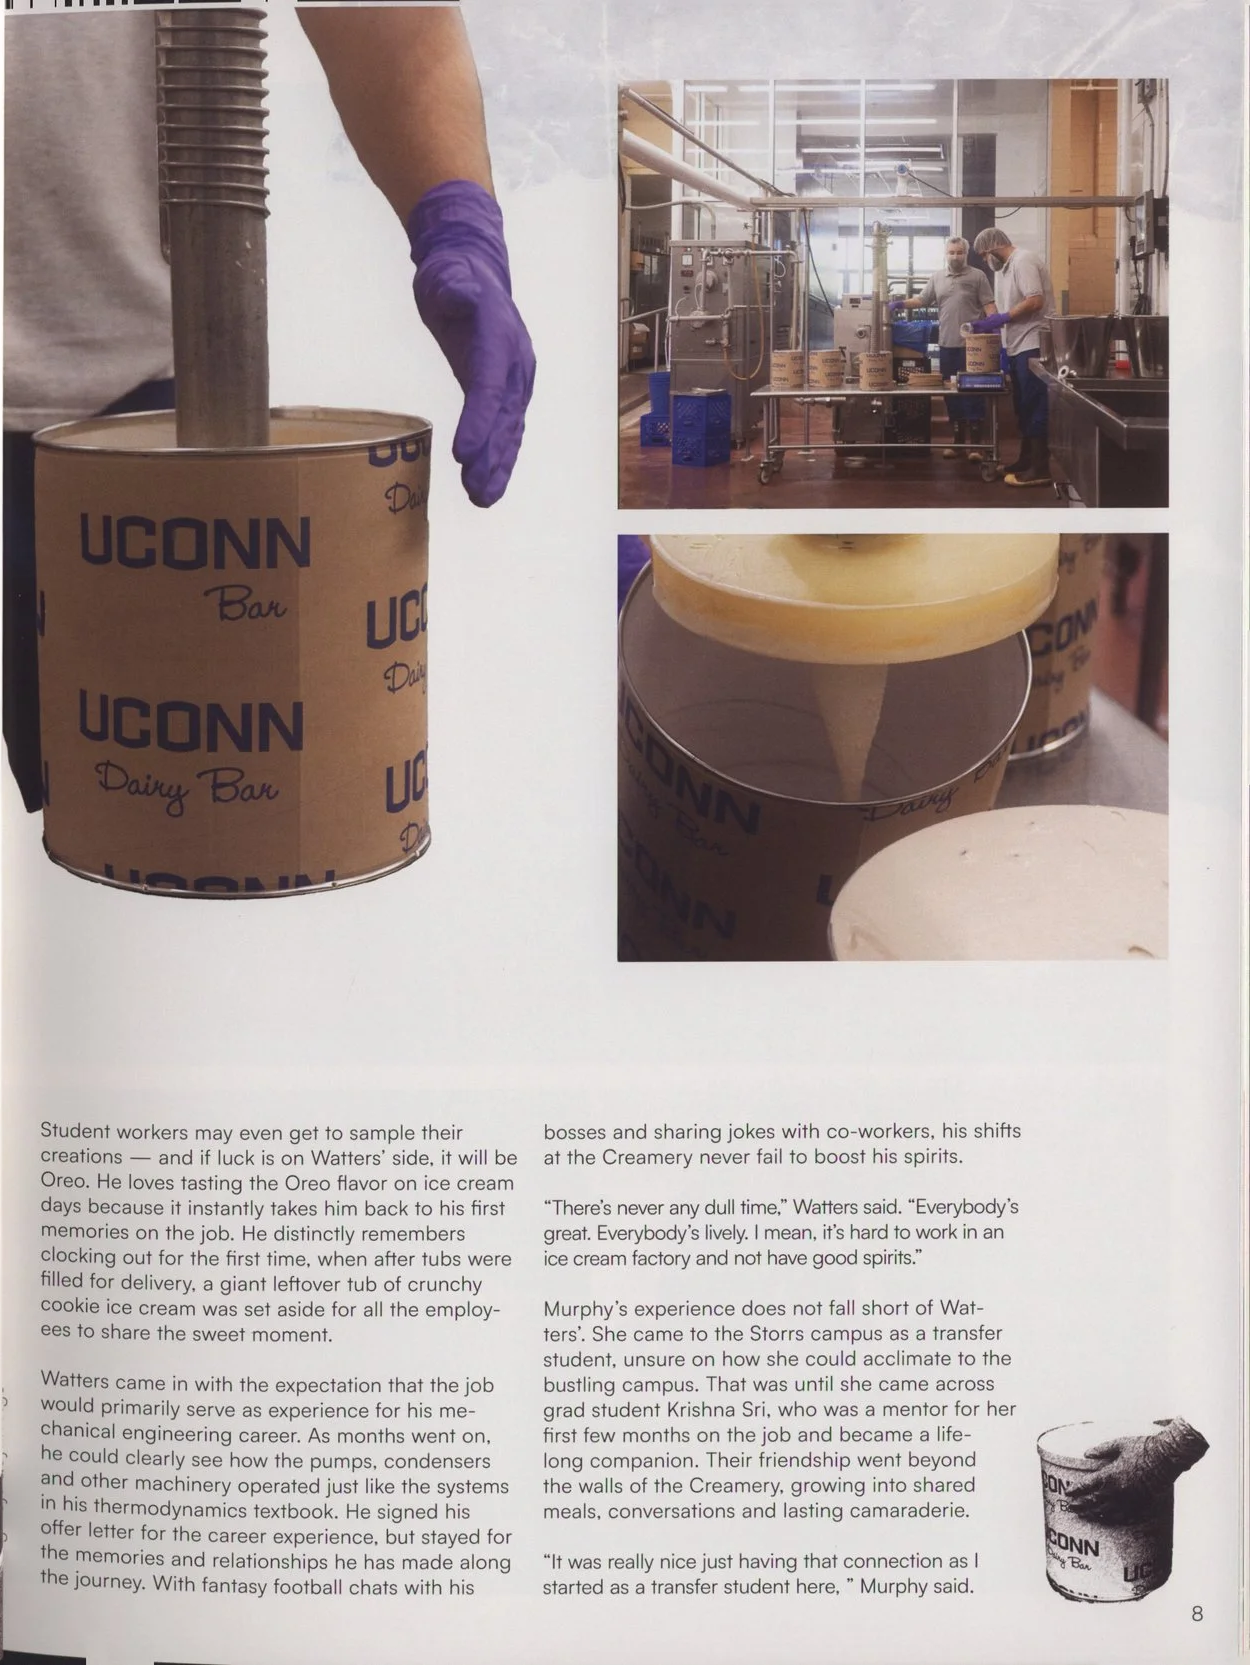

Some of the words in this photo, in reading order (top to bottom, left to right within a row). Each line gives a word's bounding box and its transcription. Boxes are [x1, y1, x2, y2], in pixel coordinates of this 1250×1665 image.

[81, 513, 310, 570] UCONN
[204, 584, 287, 621] Bar
[80, 688, 303, 752] UCONN
[95, 760, 189, 817] Dairy
[196, 767, 278, 803] Bar
[386, 741, 428, 813] UC
[41, 1121, 110, 1139] Student
[117, 1124, 188, 1140] workers
[196, 1129, 233, 1144] may
[240, 1129, 282, 1140] even
[290, 1126, 319, 1145] get
[325, 1126, 343, 1140] to
[350, 1124, 415, 1144] sample
[422, 1124, 463, 1140] their
[545, 1124, 606, 1140] bosses
[613, 1123, 647, 1140] and
[654, 1123, 721, 1143] sharing
[727, 1123, 775, 1143] jokes
[782, 1123, 819, 1139] with
[827, 1122, 934, 1140] co-workers,
[943, 1122, 967, 1138] his
[974, 1122, 1021, 1138] shifts
[544, 1199, 611, 1216] “There’s
[618, 1204, 664, 1215] never
[670, 1203, 700, 1219] any
[705, 1199, 735, 1215] dull
[740, 1198, 787, 1216] time,”
[793, 1199, 858, 1215] Watters
[863, 1198, 902, 1214] said.
[908, 1198, 1019, 1218] “Everybody’s
[41, 1370, 109, 1389] Watters
[116, 1378, 165, 1391] came
[173, 1376, 187, 1391] in
[195, 1376, 232, 1392] with
[240, 1376, 268, 1392] the
[276, 1377, 381, 1397] expectation
[388, 1377, 424, 1393] that
[430, 1377, 459, 1393] the
[464, 1377, 494, 1397] job
[544, 1401, 584, 1422] grad
[592, 1401, 661, 1418] student
[668, 1401, 735, 1417] Krishna
[742, 1401, 770, 1419] Sri,
[778, 1401, 817, 1417] who
[823, 1405, 858, 1417] was
[865, 1405, 875, 1417] a
[883, 1402, 948, 1416] mentor
[954, 1400, 980, 1416] for
[987, 1400, 1016, 1416] her
[544, 1502, 601, 1520] meals,
[608, 1503, 735, 1519] conversations
[742, 1502, 776, 1518] and
[784, 1502, 843, 1522] lasting
[850, 1501, 969, 1518] camaraderie.
[1067, 1556, 1092, 1571] Bar
[40, 1568, 68, 1585] the
[74, 1570, 145, 1593] journey.
[153, 1575, 195, 1592] With
[202, 1576, 267, 1598] fantasy
[273, 1578, 342, 1595] football
[349, 1579, 397, 1595] chats
[404, 1579, 442, 1595] with
[450, 1579, 474, 1595] his
[1192, 1606, 1203, 1621] 8
